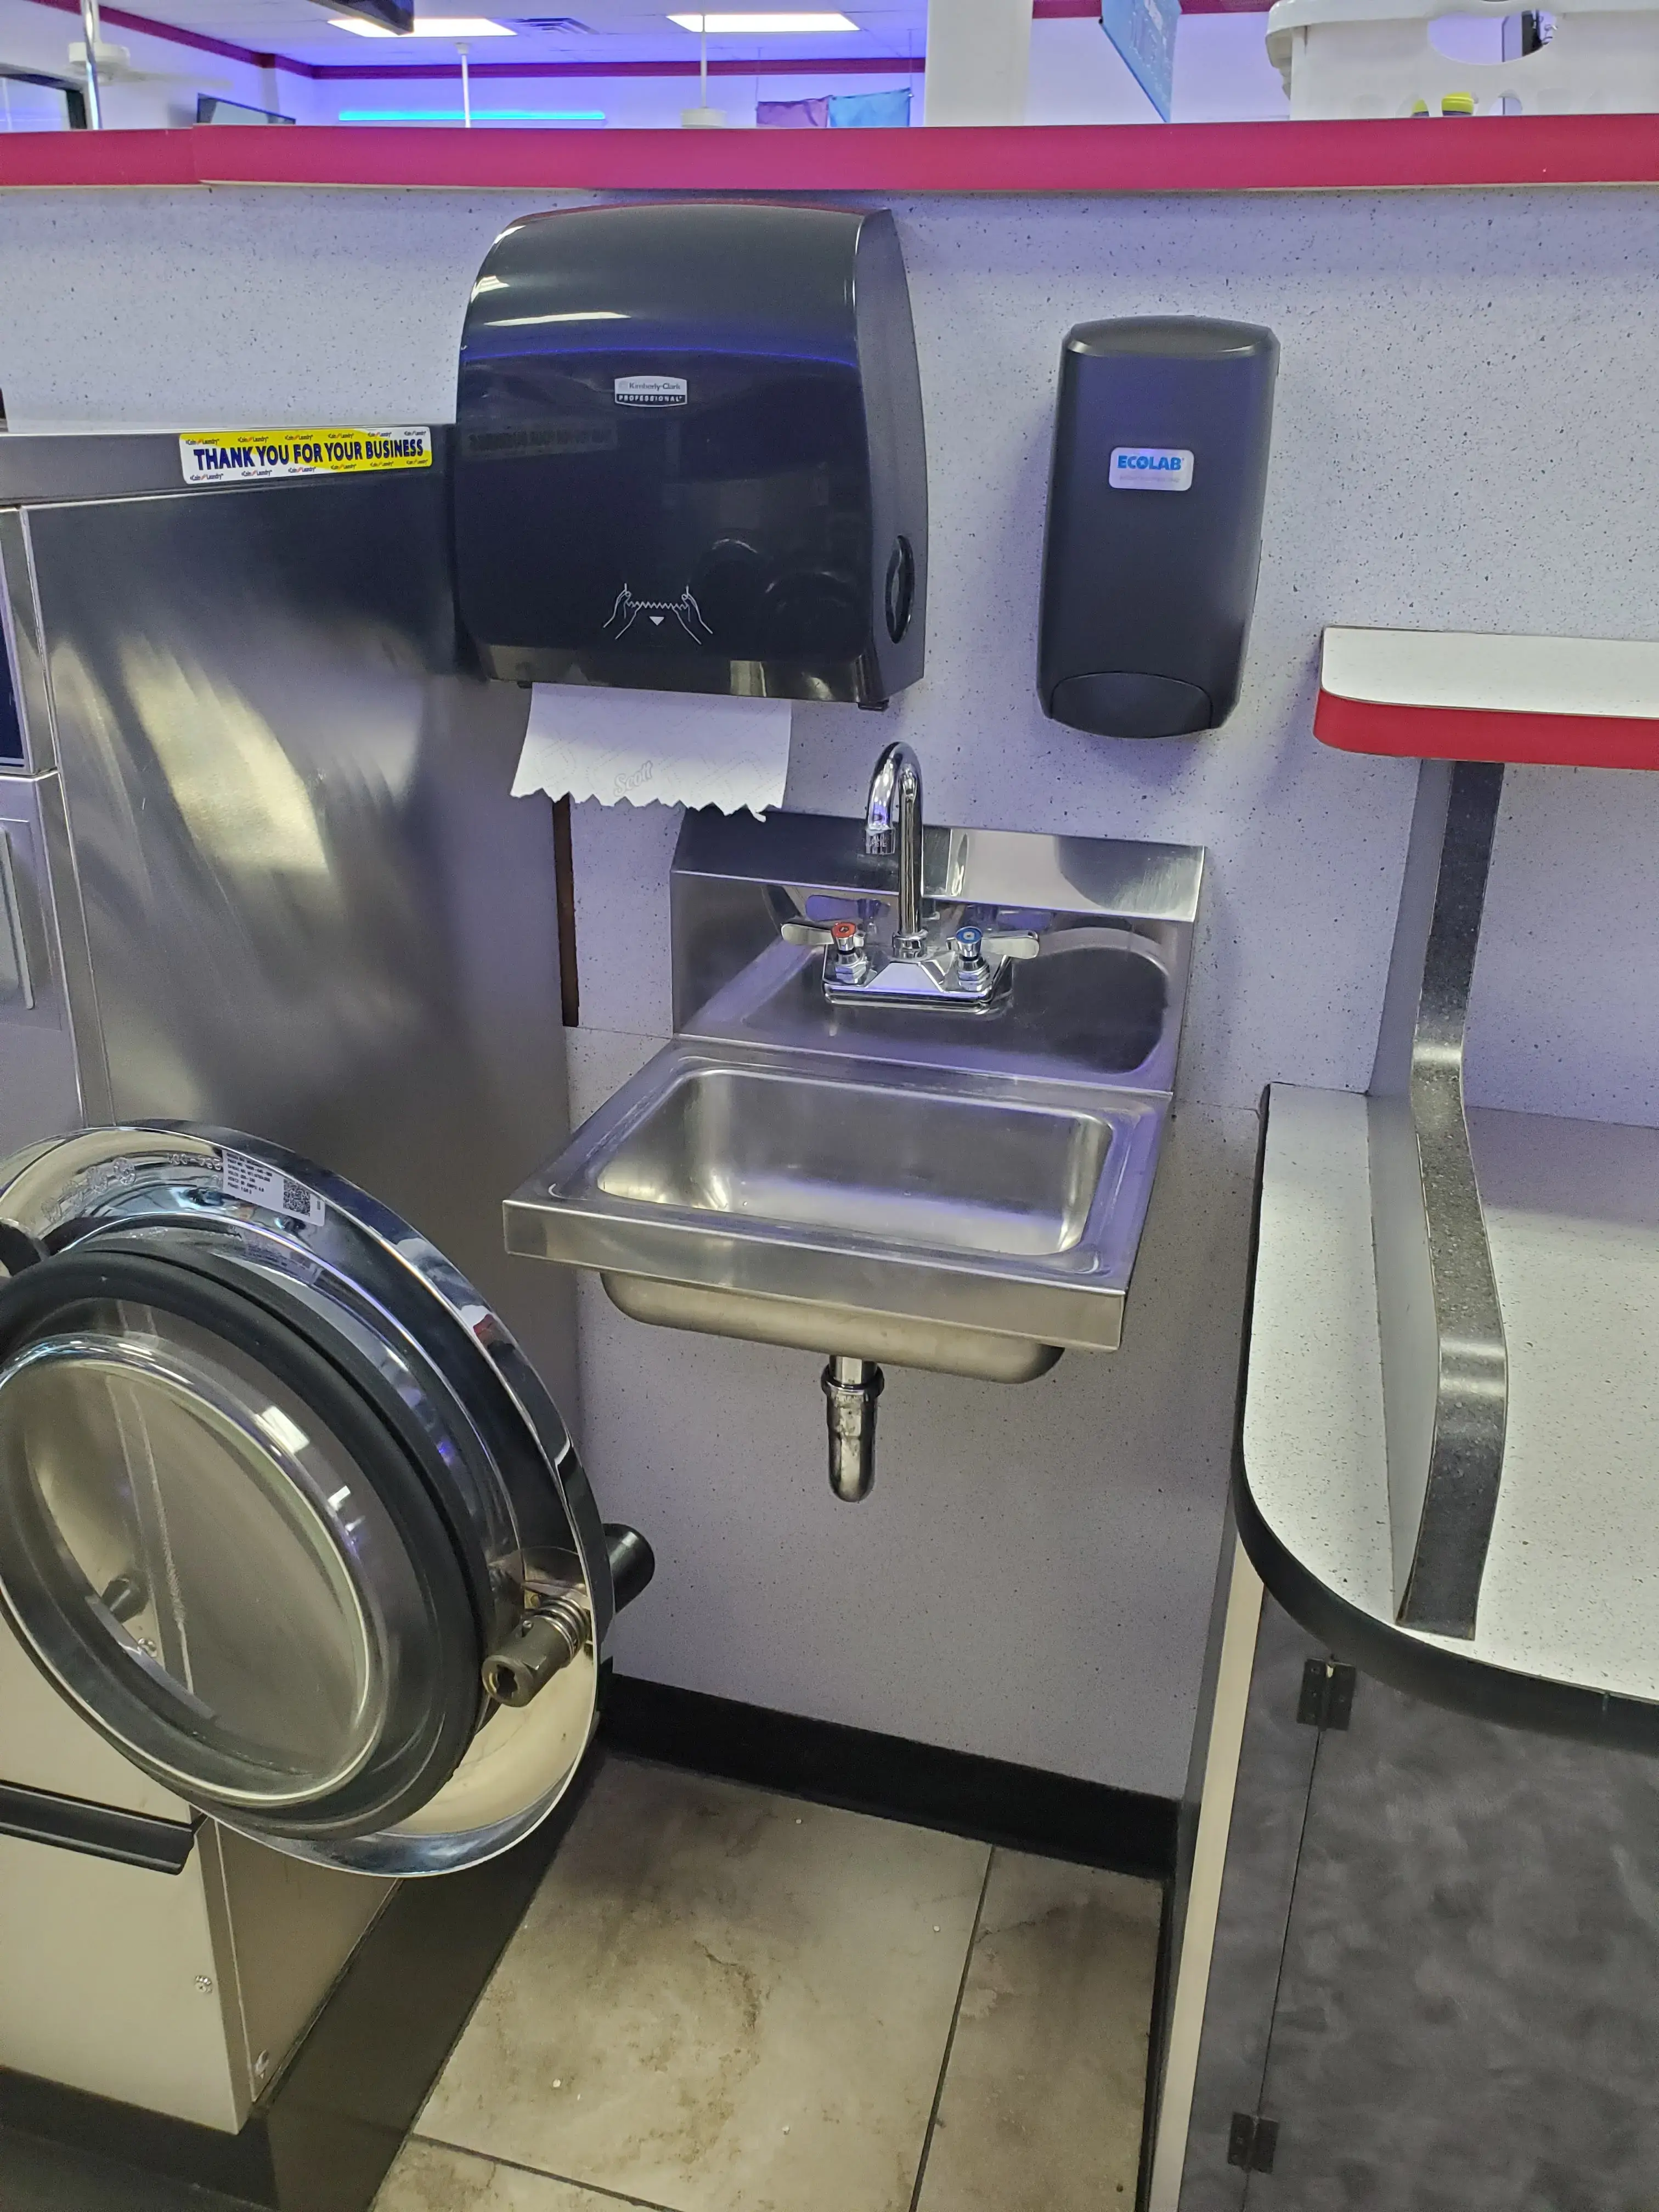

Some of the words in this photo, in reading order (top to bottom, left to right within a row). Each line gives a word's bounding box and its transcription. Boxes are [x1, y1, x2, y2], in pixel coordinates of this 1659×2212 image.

[629, 382, 681, 392] Kimberly-Clark
[194, 446, 255, 470] THANK
[256, 444, 289, 466] YOU
[293, 443, 323, 464] FOR
[324, 441, 363, 462] YOUR
[365, 438, 424, 459] BUSINESS
[1118, 455, 1181, 471] ECOLAB
[613, 760, 653, 797] Scott
